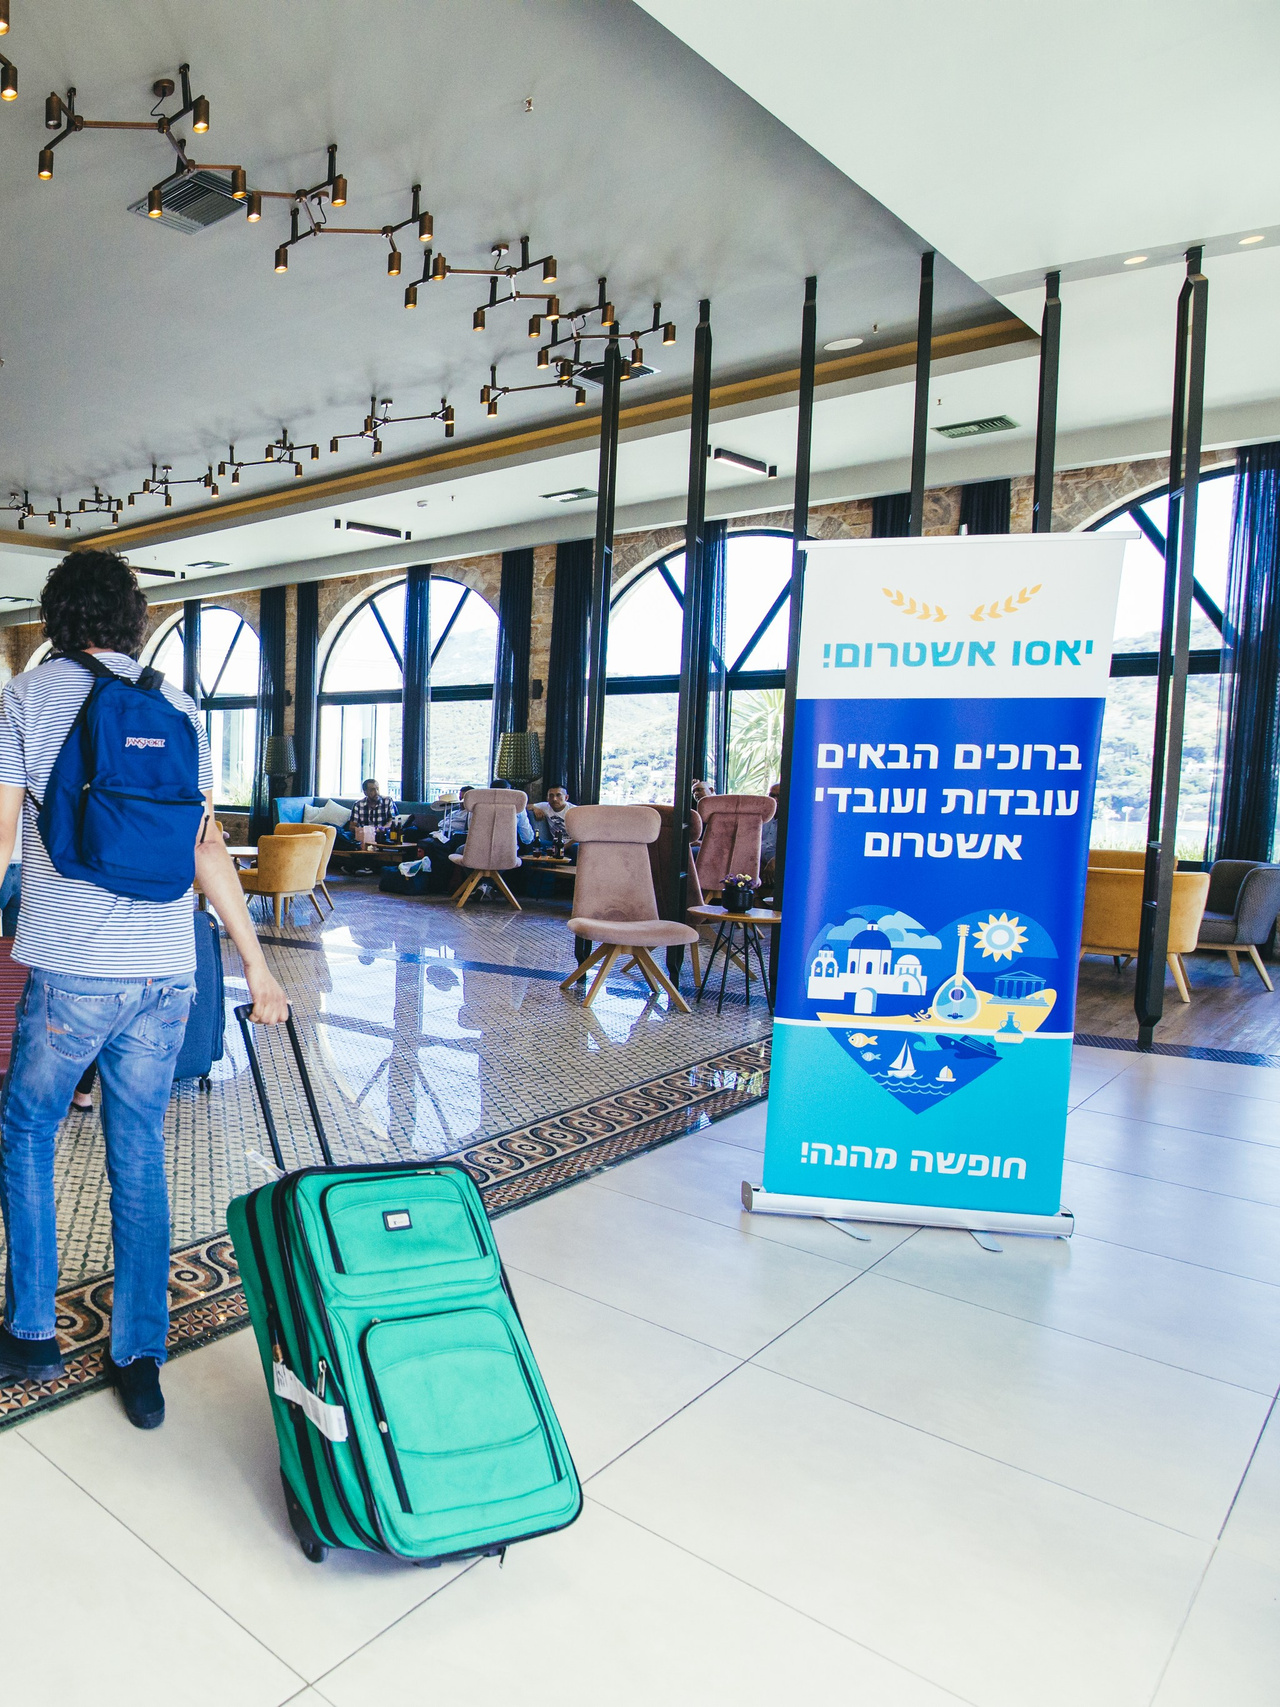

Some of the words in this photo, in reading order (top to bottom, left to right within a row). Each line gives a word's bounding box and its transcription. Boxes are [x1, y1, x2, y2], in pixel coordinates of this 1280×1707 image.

[823, 640, 996, 669] אשטרום!
[1011, 639, 1094, 667] יאסו
[125, 737, 165, 748] JANSPORT
[816, 742, 939, 770] הבאים
[953, 743, 1083, 771] ברוכים
[814, 786, 927, 814] ועובדי
[940, 788, 1080, 816] עובדות
[863, 831, 1023, 861] אשטרום
[800, 1141, 898, 1170] מהנה!
[909, 1149, 1028, 1180] חופשה
